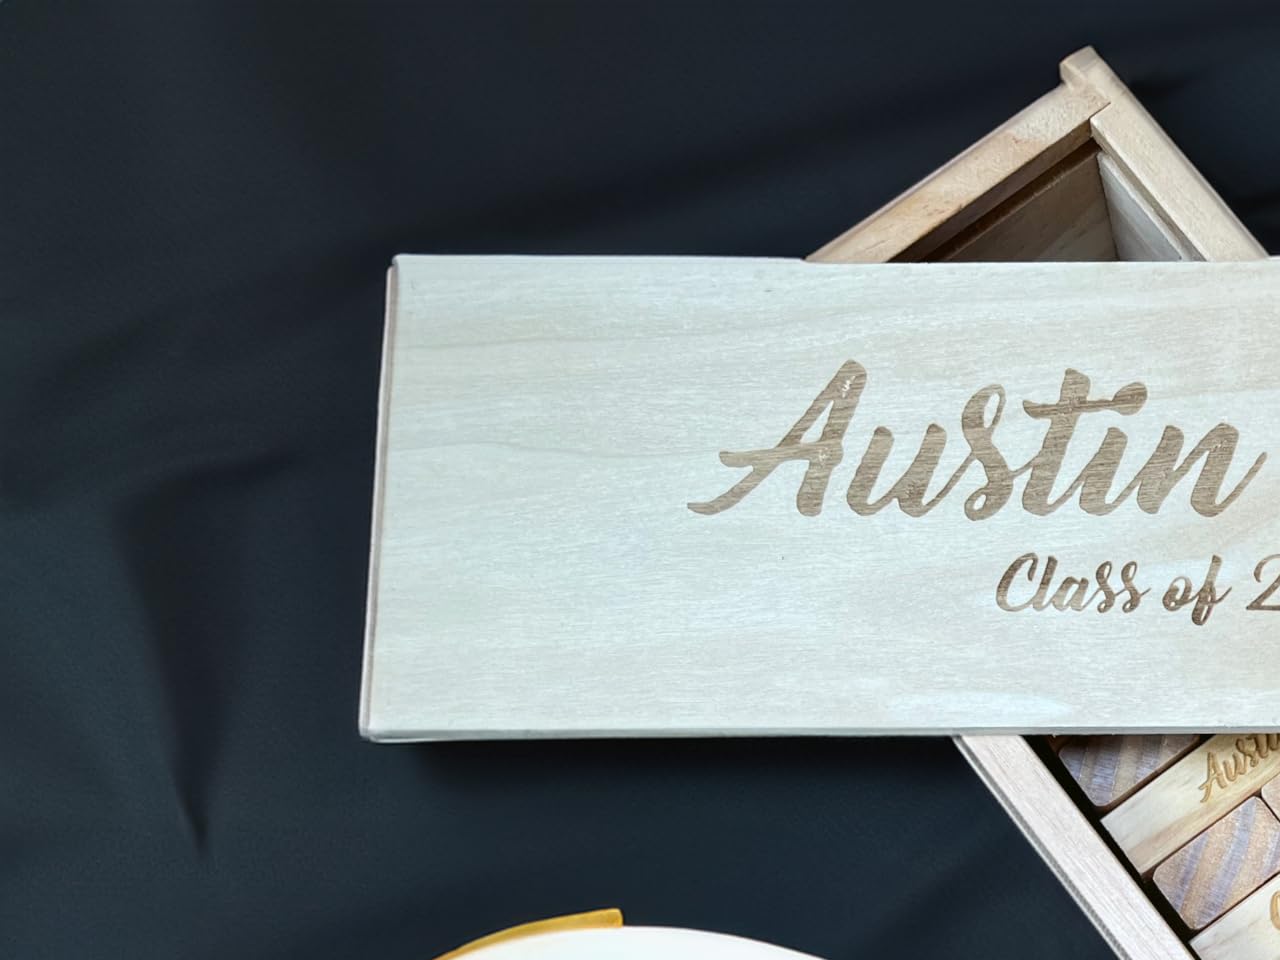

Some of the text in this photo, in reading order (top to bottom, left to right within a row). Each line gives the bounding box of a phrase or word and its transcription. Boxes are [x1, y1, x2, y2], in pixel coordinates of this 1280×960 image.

[687, 358, 1267, 521] Austin
[995, 552, 1150, 613] Class
[1161, 554, 1232, 627] of
